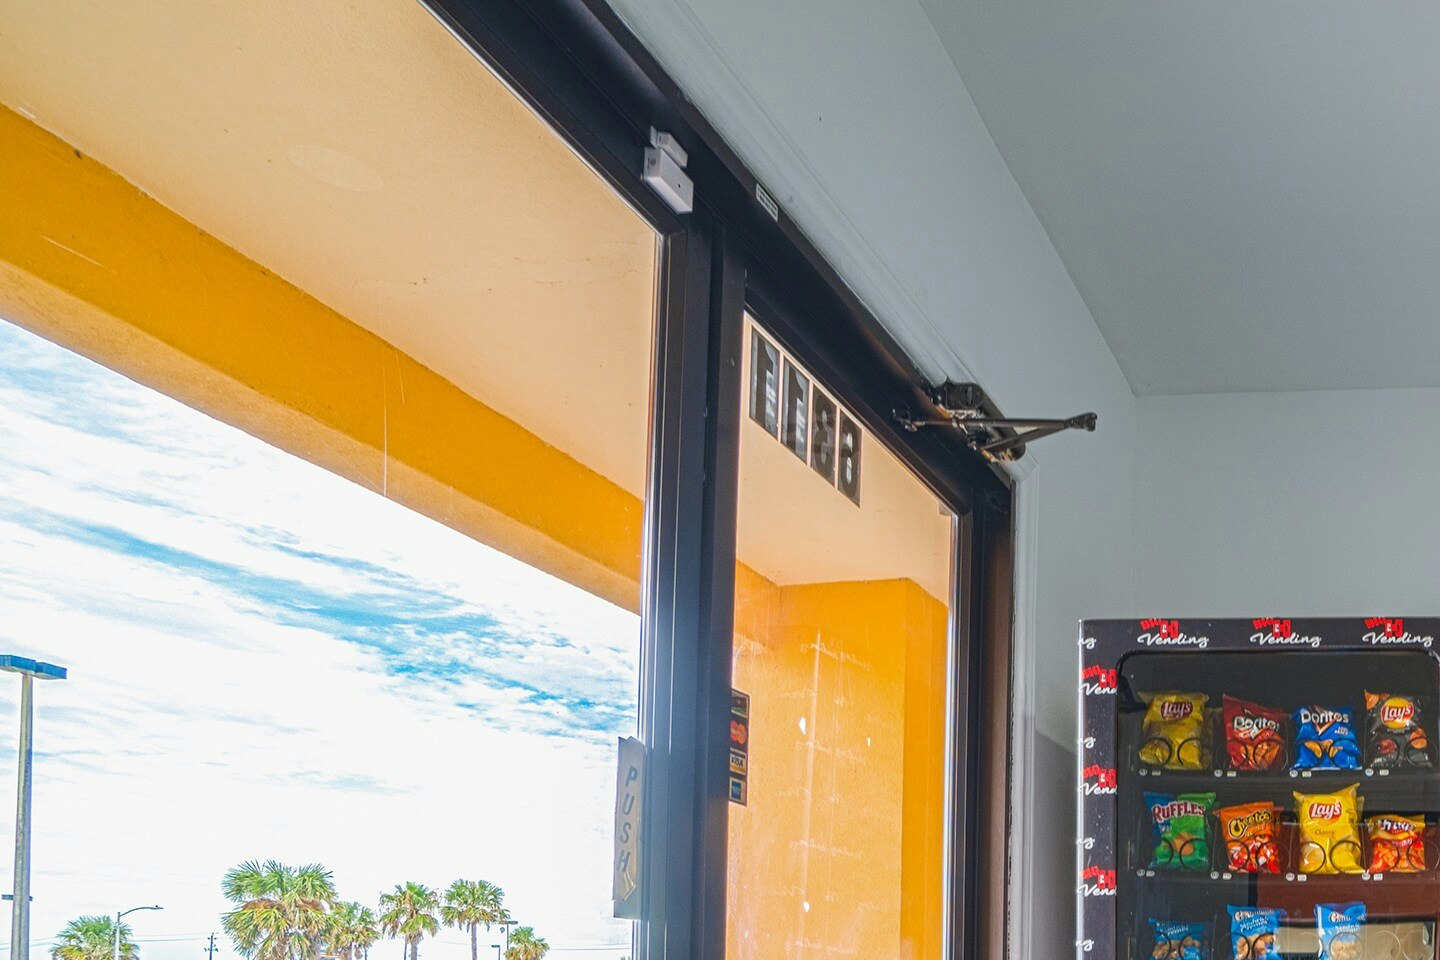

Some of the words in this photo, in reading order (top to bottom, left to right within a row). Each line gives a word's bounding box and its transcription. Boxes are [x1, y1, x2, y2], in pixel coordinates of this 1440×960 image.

[1137, 632, 1210, 649] Vending
[1250, 632, 1322, 648] Vending
[1362, 631, 1434, 648] Vending
[1163, 702, 1192, 718] Lay's
[1300, 710, 1349, 723] Doritos
[1383, 704, 1412, 721] Lay's
[1152, 801, 1205, 822] RUFFLES
[1310, 801, 1341, 820] Lay's
[617, 766, 638, 873] PUSH
[1228, 810, 1272, 839] Cheetos
